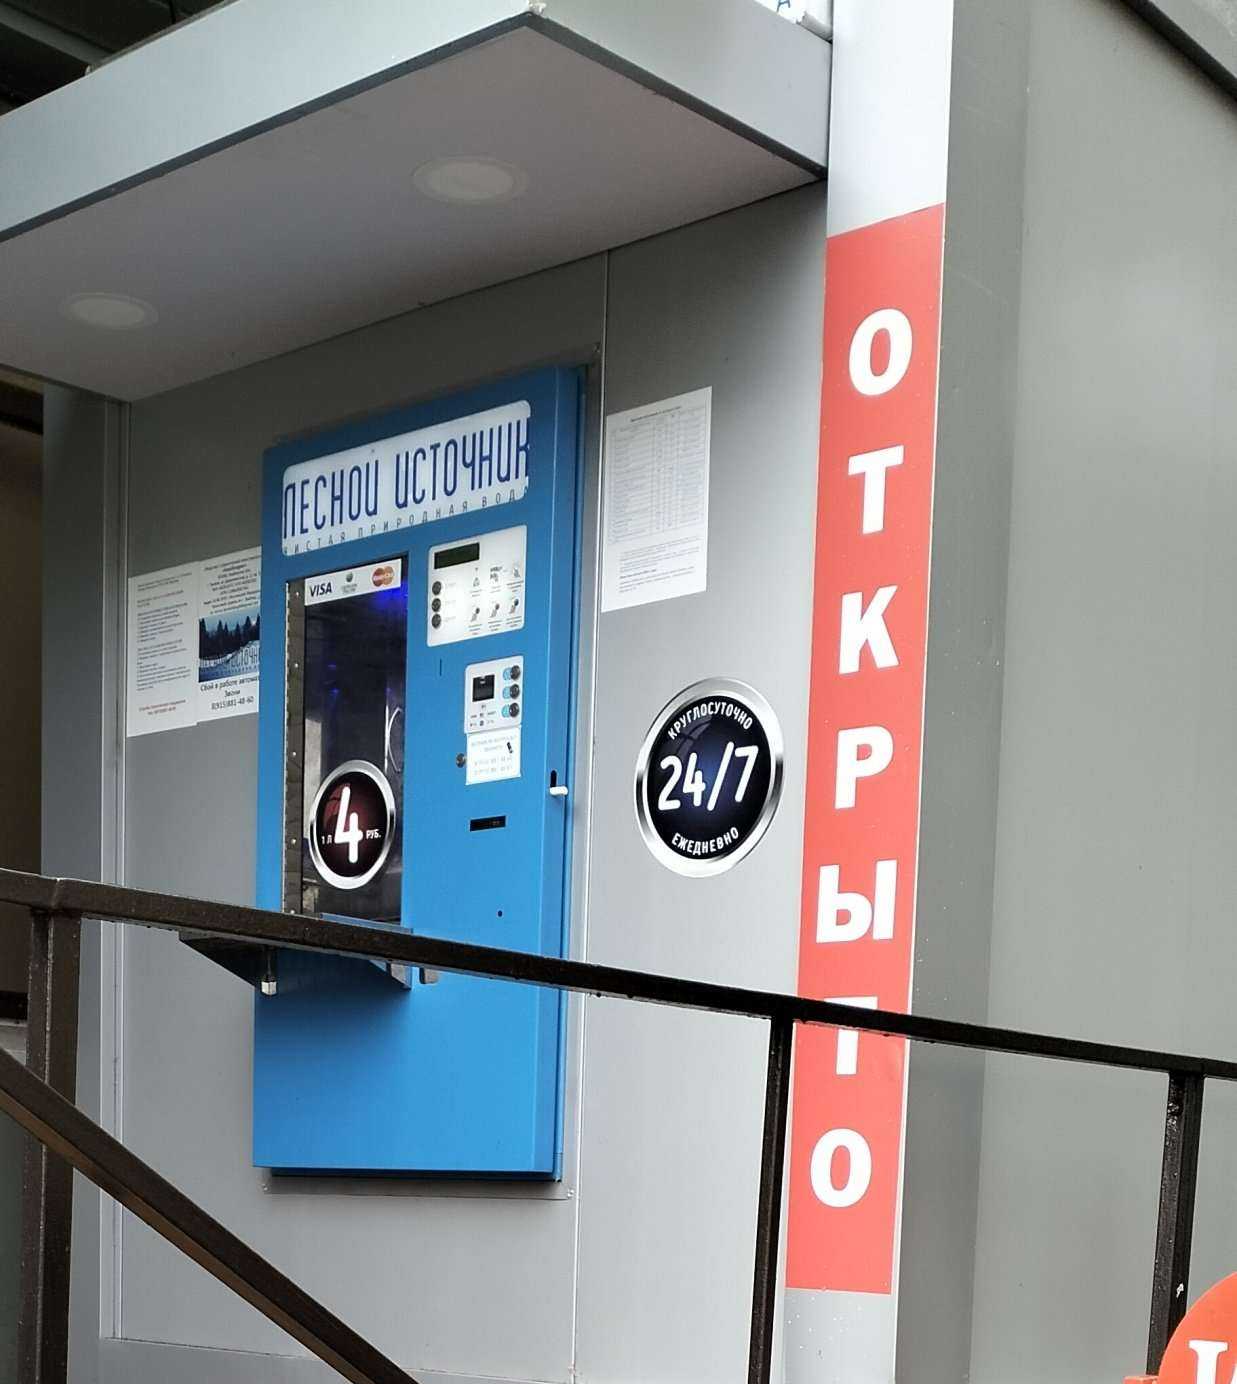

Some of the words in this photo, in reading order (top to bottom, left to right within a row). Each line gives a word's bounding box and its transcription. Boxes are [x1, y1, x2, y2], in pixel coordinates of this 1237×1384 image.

[395, 417, 530, 510] ИСТОЧНИК
[358, 500, 468, 535] ПРИРОДНАЯ
[310, 581, 332, 598] VISA
[667, 701, 753, 740] КРУГЛОСУТОЧНО
[657, 741, 759, 812] 24/7
[810, 307, 913, 1208] ОТКРЫТО
[334, 786, 364, 863] 4
[671, 826, 740, 856] ЕЖЕДНЕВНО
